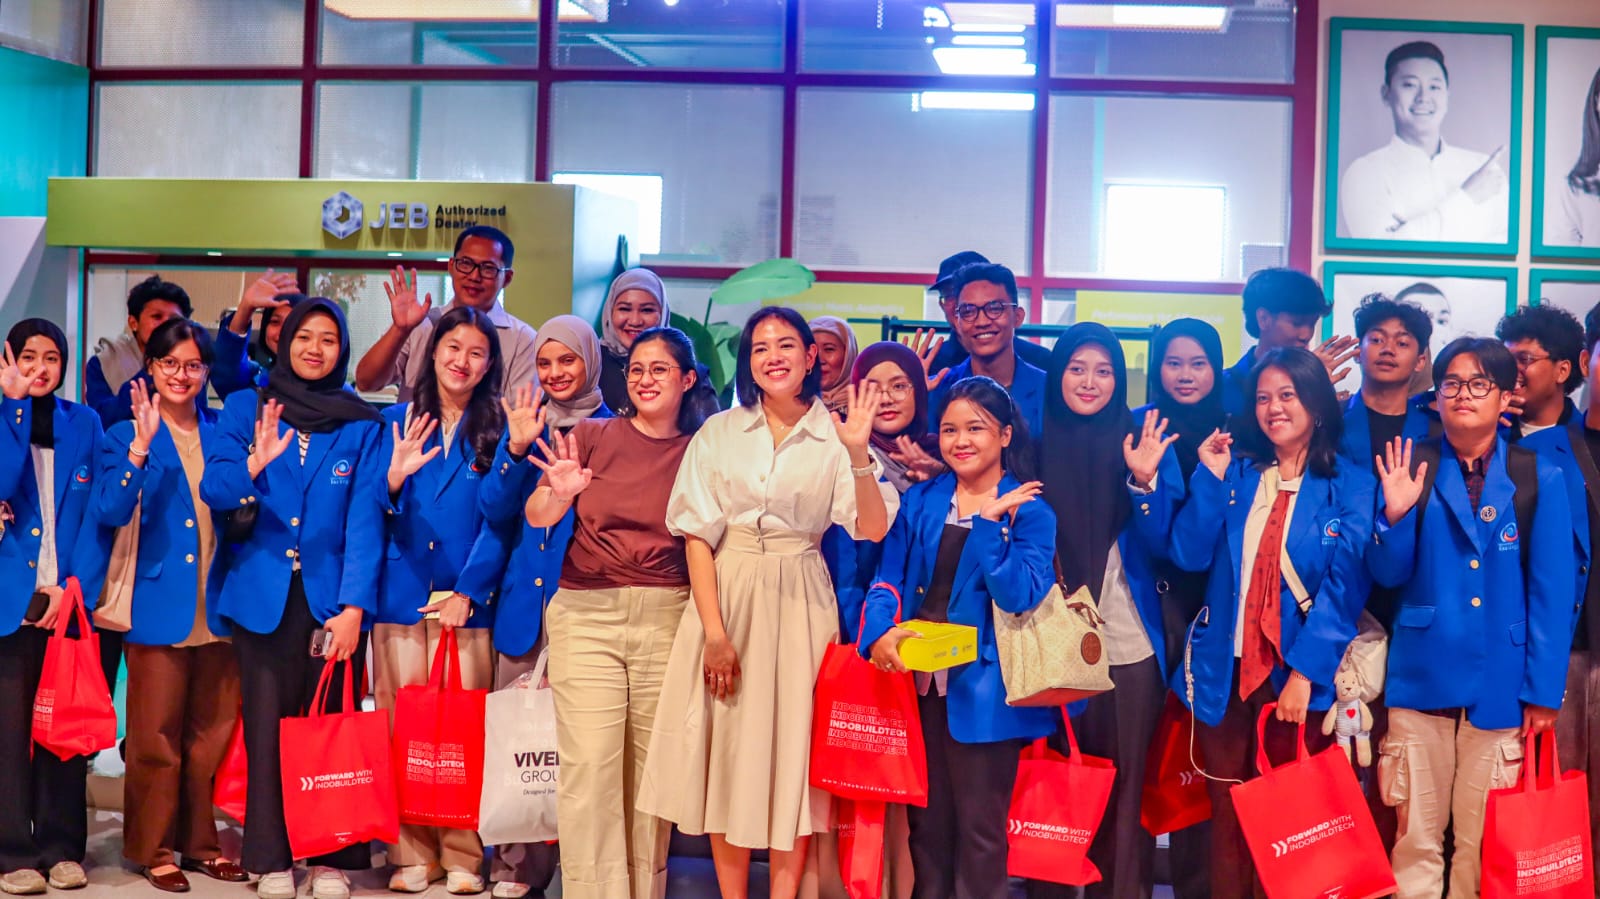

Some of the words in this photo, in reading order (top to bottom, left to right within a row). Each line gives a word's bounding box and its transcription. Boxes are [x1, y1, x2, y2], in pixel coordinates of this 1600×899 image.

[369, 202, 429, 229] JEB
[436, 204, 507, 217] Authorized
[435, 218, 478, 229] Dealer
[830, 719, 907, 737] INDOBUILDTECH
[314, 771, 355, 782] FORWARD
[1023, 821, 1069, 834] FORWARD
[1070, 828, 1092, 837] WITH
[1286, 821, 1330, 844] FORWARD
[1330, 814, 1352, 826] WITH
[1289, 821, 1355, 852] INDOBUILDTECH
[1517, 853, 1583, 878] INDOBUILDTECH
